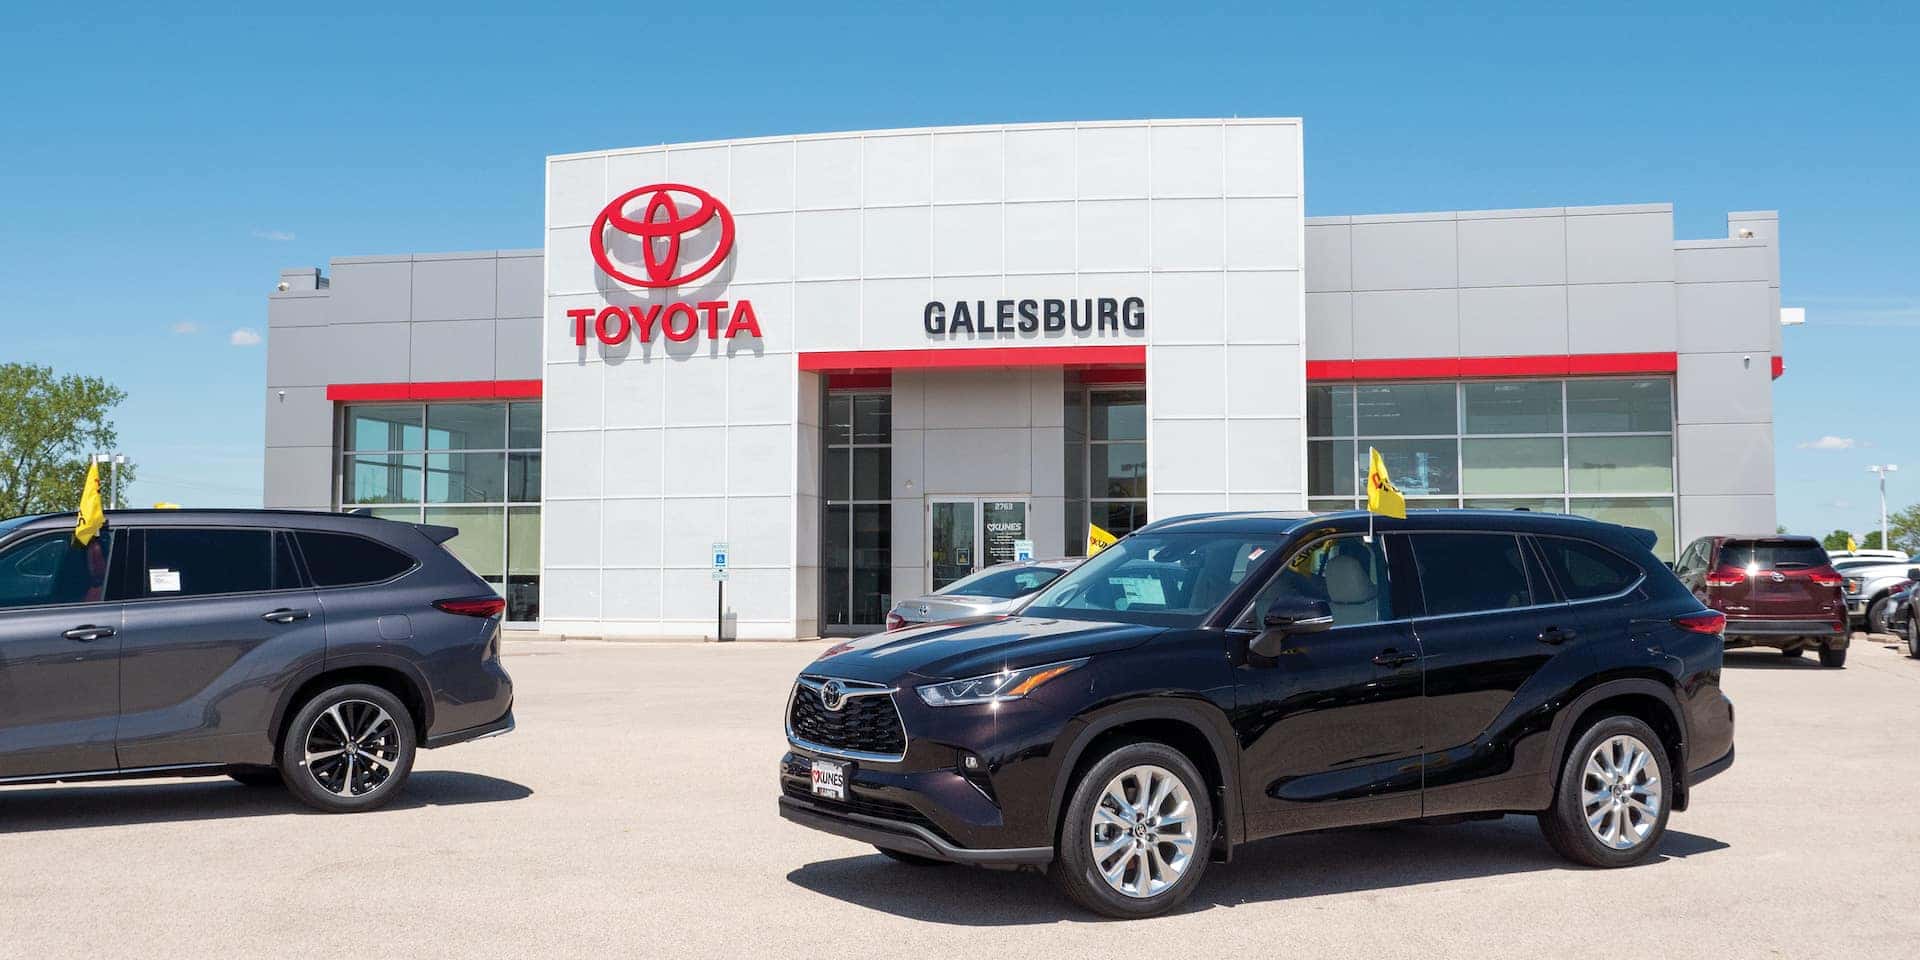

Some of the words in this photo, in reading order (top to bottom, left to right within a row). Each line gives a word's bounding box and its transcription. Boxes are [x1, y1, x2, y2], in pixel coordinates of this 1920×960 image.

[567, 300, 763, 346] TOYOTA
[924, 297, 1144, 334] GALESBURG
[992, 522, 1022, 531] KUNES
[818, 770, 844, 787] KUNES
